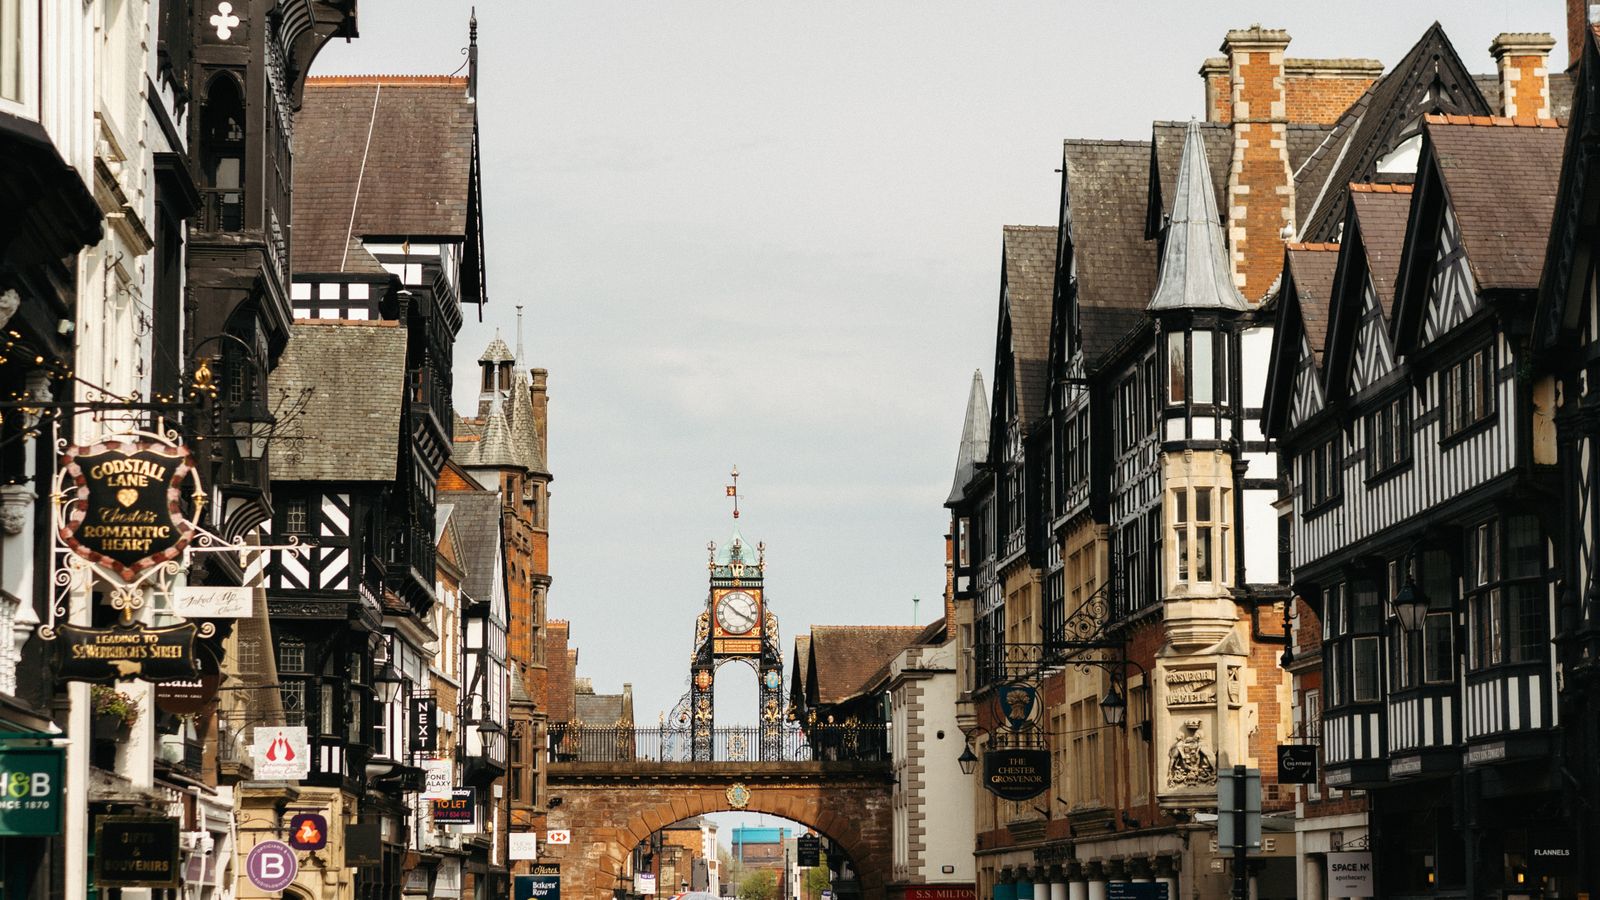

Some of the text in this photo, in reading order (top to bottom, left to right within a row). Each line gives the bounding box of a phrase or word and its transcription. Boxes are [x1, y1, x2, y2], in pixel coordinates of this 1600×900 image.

[91, 459, 166, 481] GODSTALL
[108, 474, 149, 487] LANE
[84, 525, 170, 538] ROMANTIC
[102, 539, 152, 550] HEART
[96, 634, 159, 643] LEADING TO
[150, 644, 182, 658] STREET
[418, 702, 428, 747] NEXT
[991, 775, 1042, 783] GROSVENOR
[0, 801, 49, 809] NCE 1870
[437, 800, 467, 808] TO LET
[103, 860, 169, 872] SOUVENIRS
[261, 853, 285, 879] B
